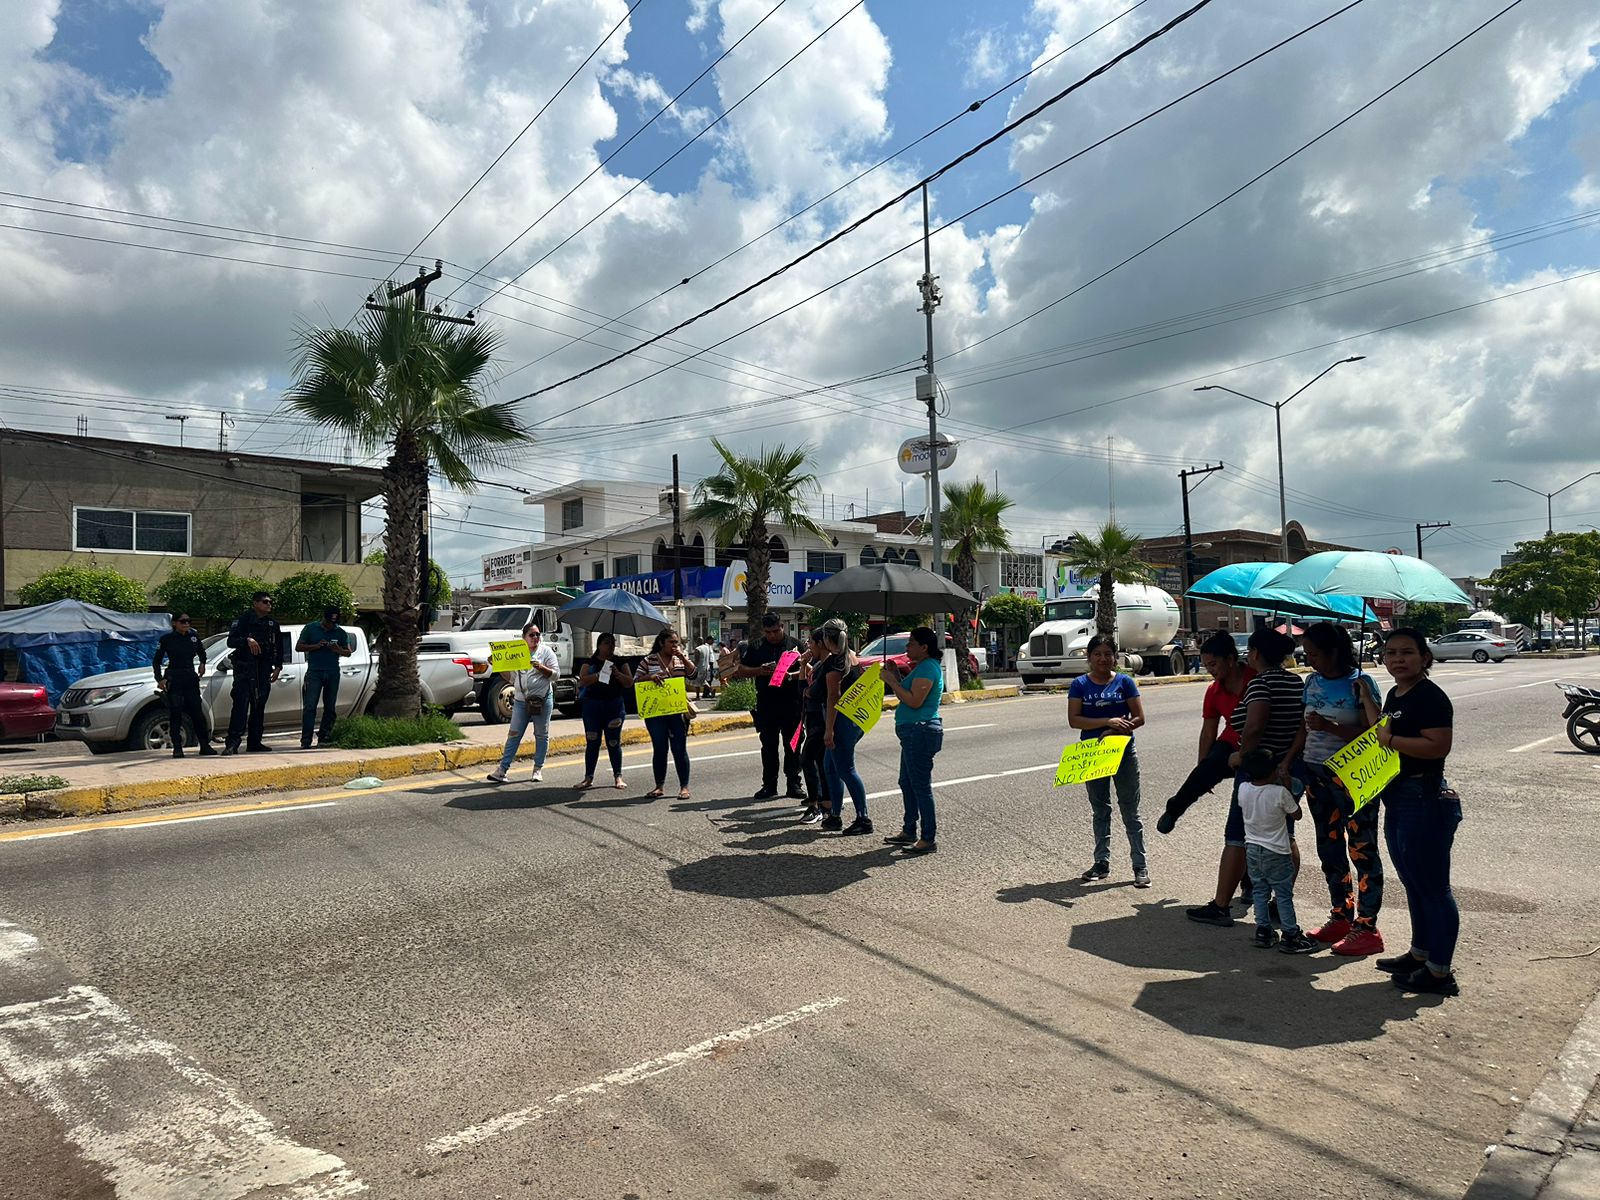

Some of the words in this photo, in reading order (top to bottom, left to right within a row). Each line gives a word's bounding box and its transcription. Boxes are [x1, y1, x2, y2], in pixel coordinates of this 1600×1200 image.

[490, 553, 515, 569] FORRAJES
[490, 569, 497, 578] EL
[493, 652, 503, 661] NO
[852, 707, 870, 724] NO
